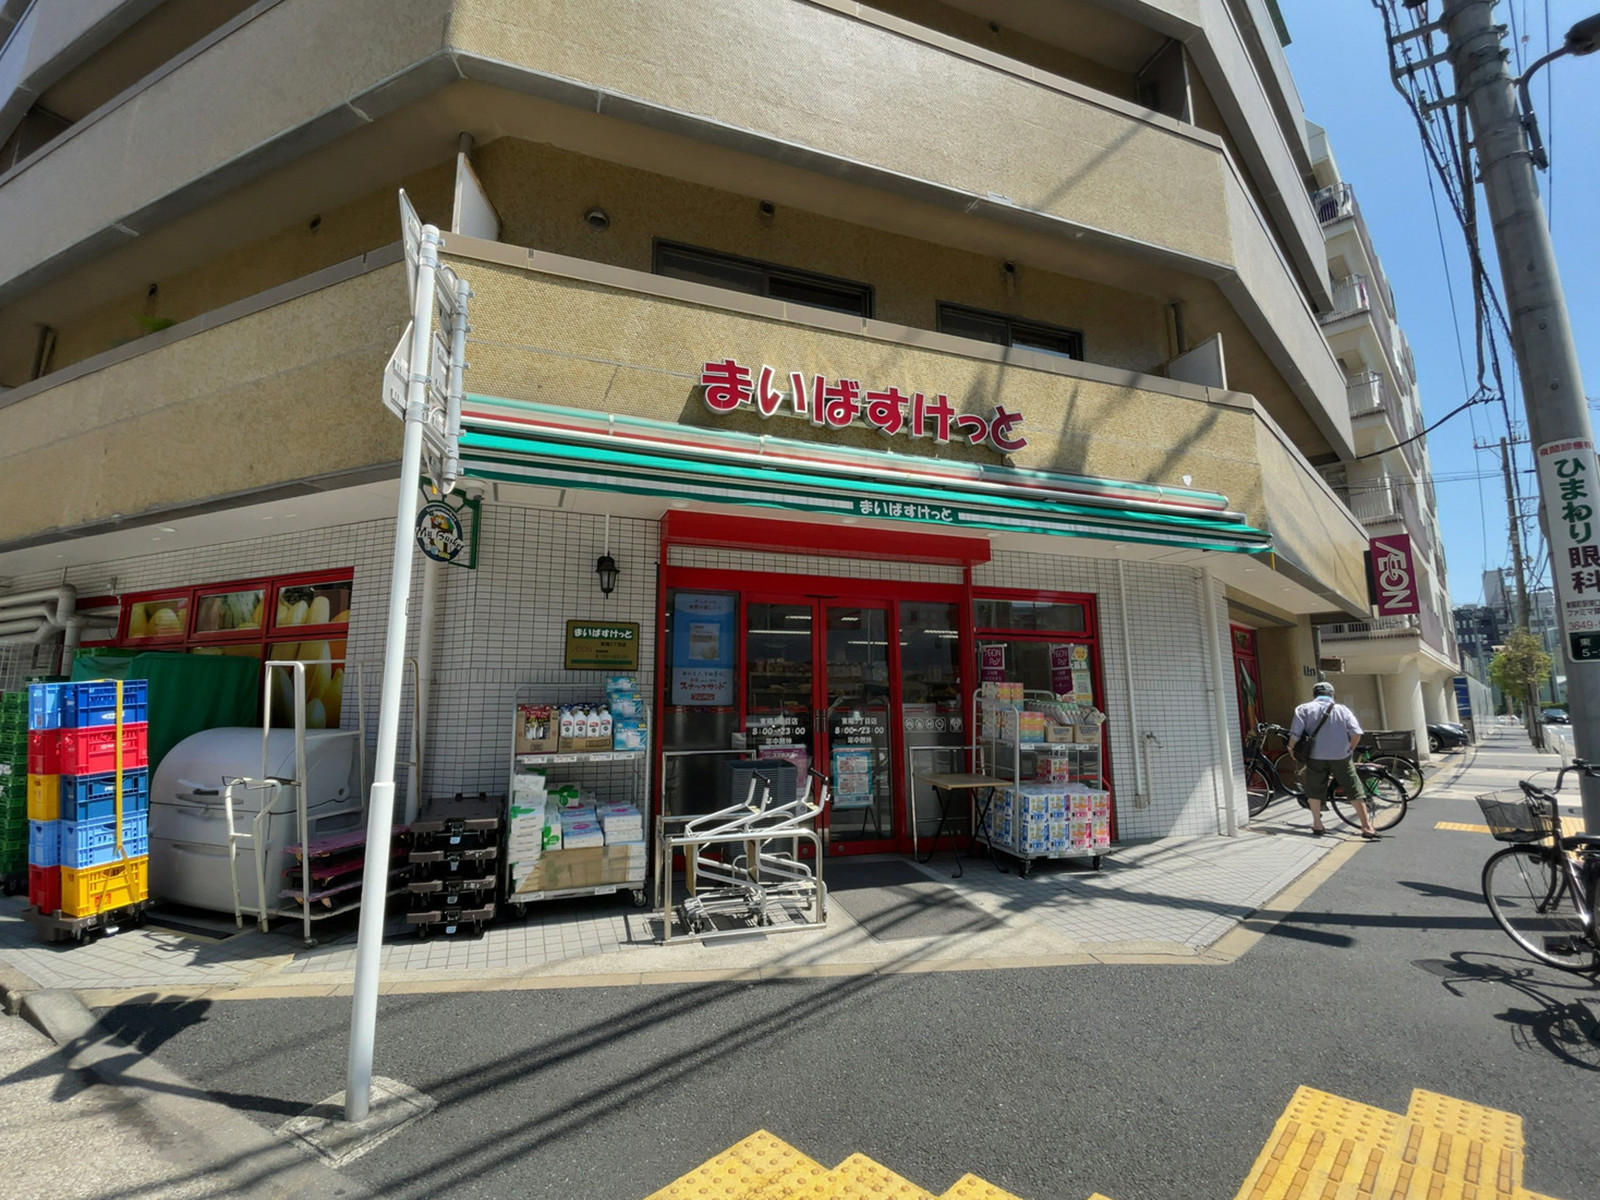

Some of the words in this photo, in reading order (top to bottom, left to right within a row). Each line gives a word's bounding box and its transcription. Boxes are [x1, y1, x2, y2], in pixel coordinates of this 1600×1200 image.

[701, 358, 1028, 453] まいばすけっと
[859, 500, 953, 522] まいばすけっと
[415, 525, 433, 540] My
[1375, 541, 1413, 609] AEON
[1568, 620, 1600, 631] 3649-
[573, 627, 633, 640] まいばすけっと
[1582, 649, 1600, 657] 5-
